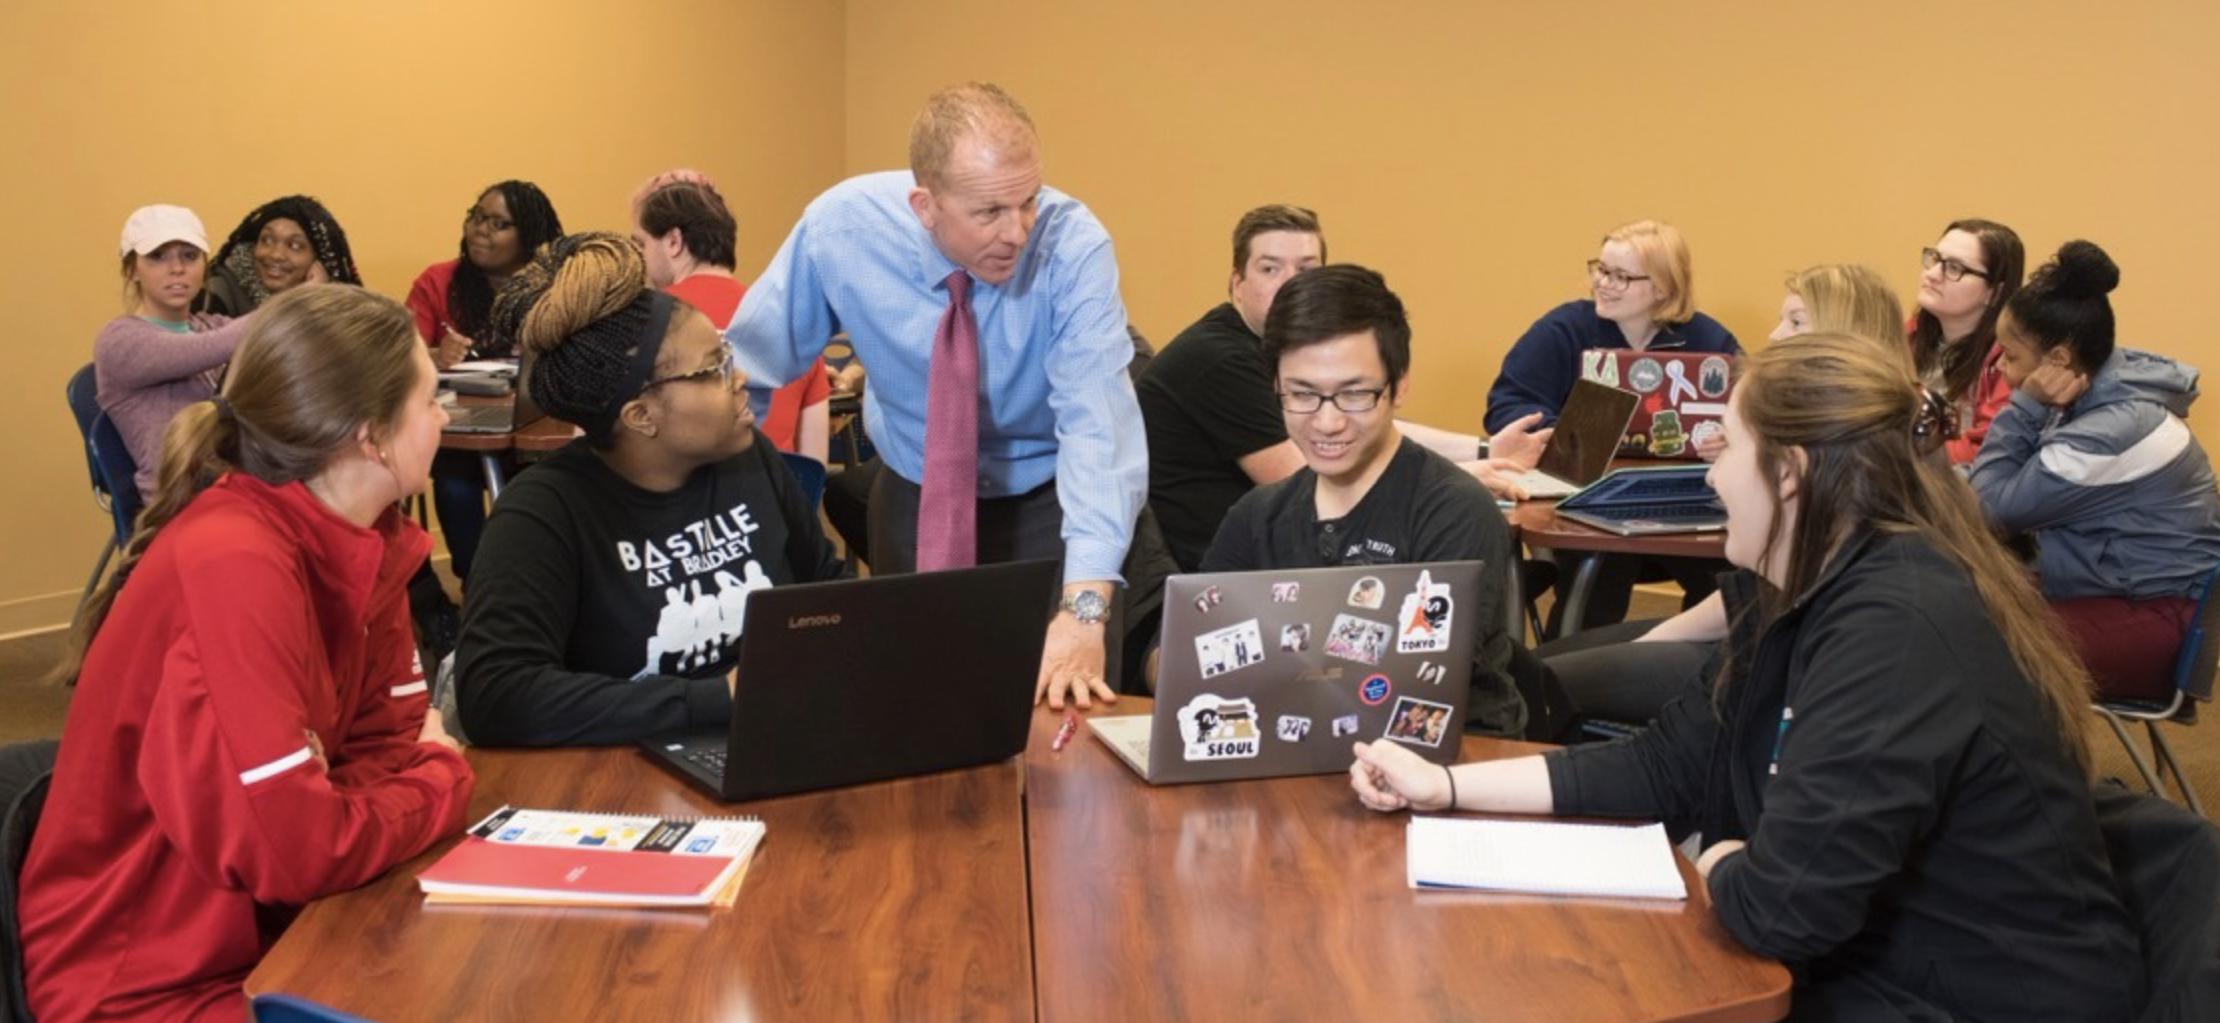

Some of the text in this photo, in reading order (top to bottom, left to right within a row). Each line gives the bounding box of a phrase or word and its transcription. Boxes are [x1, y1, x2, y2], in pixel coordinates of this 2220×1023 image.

[617, 504, 760, 571] BASTILLE
[647, 536, 752, 587] AT BRADLEY
[788, 614, 841, 629] Lenovo
[1402, 640, 1436, 650] TOKYO
[1207, 742, 1254, 757] SEOUL
